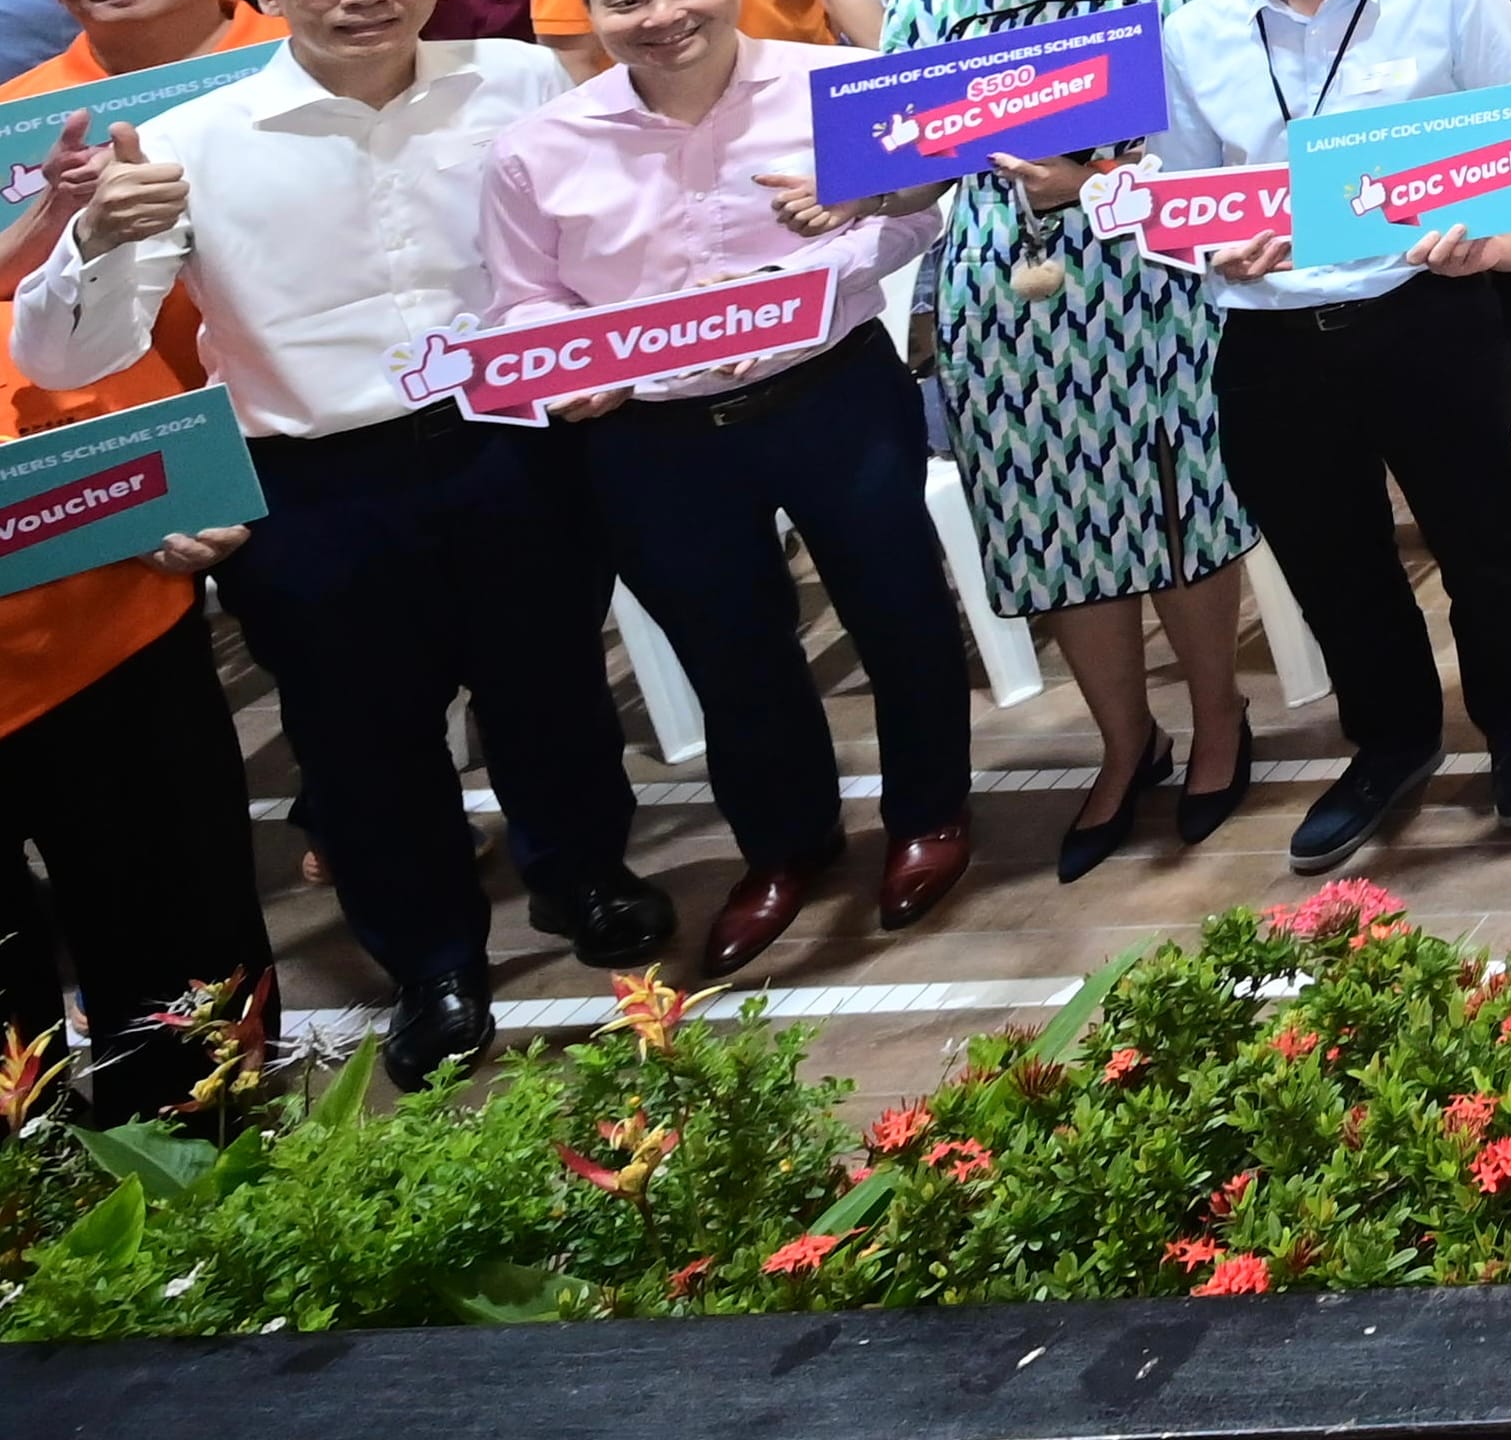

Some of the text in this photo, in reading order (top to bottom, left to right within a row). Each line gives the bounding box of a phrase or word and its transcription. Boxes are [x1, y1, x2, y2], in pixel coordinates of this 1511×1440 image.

[830, 24, 1143, 99] LAUNCH OF CDC VOUCHERS SCHEME 2024
[966, 64, 1036, 101] $500
[14, 116, 43, 134] OF
[94, 80, 200, 115] VOUCHERS
[924, 72, 1096, 141] CDC Voucher
[1306, 132, 1366, 154] LAUNCH
[1368, 128, 1389, 143] OF
[1390, 121, 1421, 140] CDC
[1423, 109, 1500, 135] VOUCHERS
[1159, 190, 1245, 229] CDC
[1390, 173, 1444, 208] CDC
[485, 296, 801, 387] CDC Voucher
[60, 428, 153, 464] SCHEME
[156, 413, 207, 437] 2024
